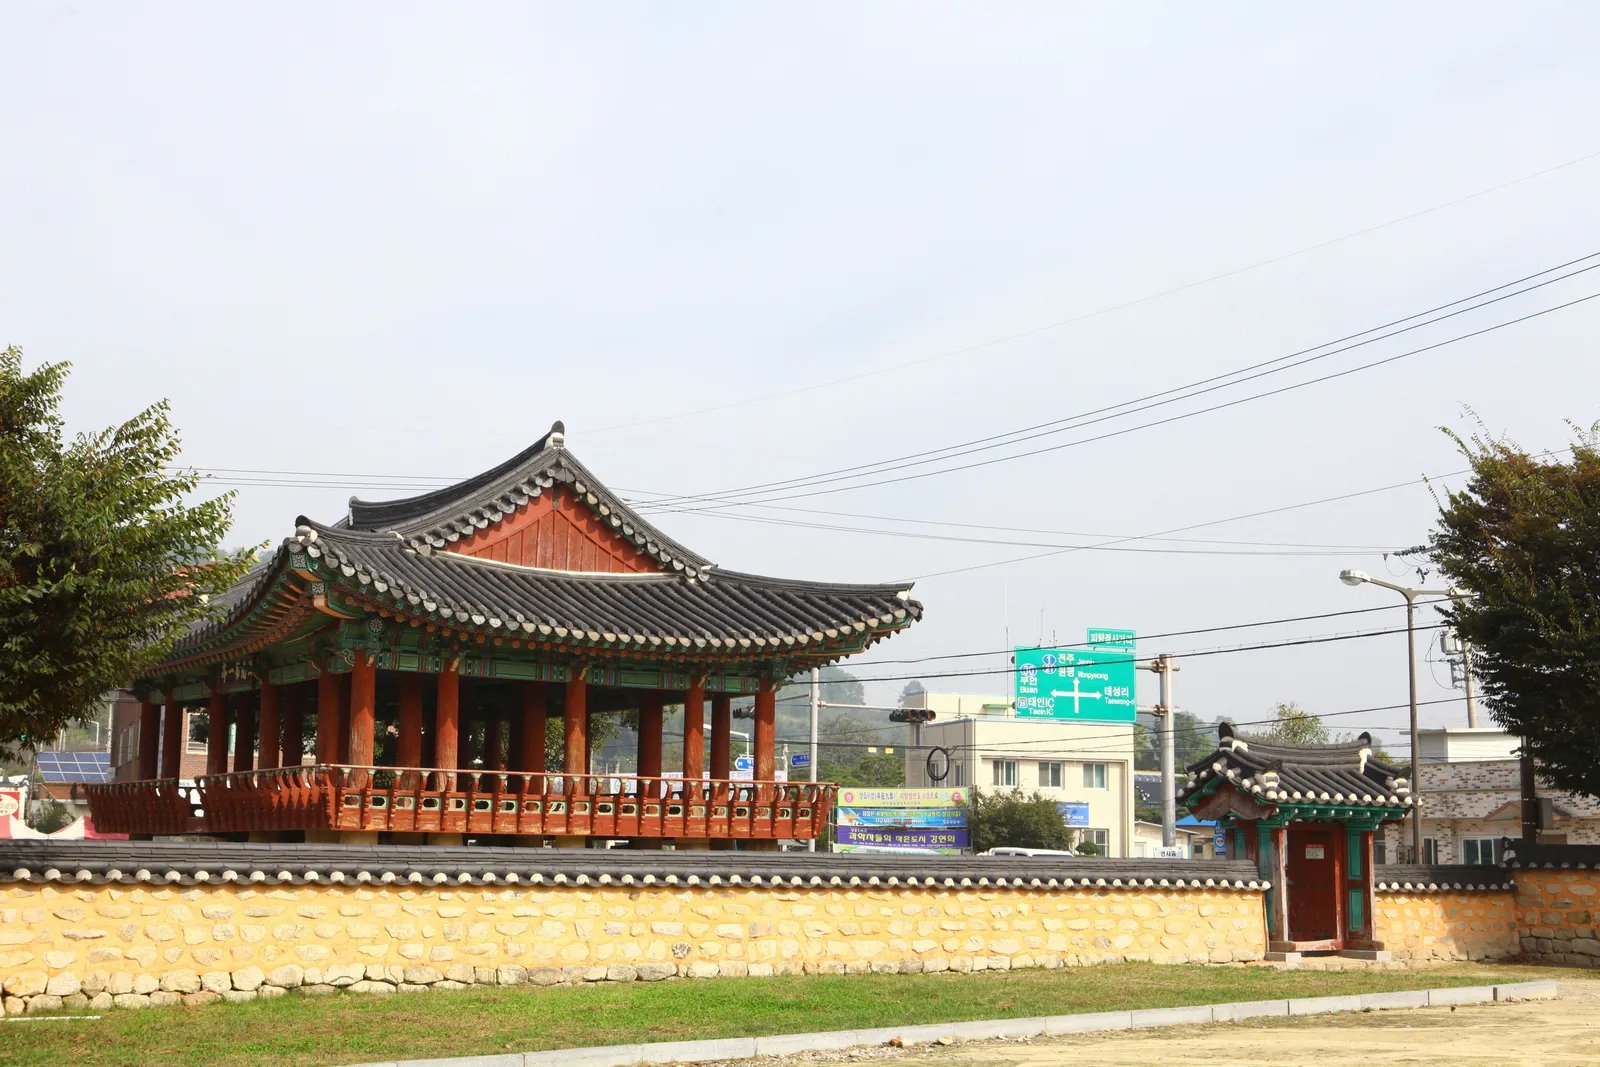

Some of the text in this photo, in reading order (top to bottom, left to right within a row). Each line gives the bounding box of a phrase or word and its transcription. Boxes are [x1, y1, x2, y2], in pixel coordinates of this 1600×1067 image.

[1058, 653, 1075, 664] 전주
[1058, 666, 1075, 677] 원평
[1077, 671, 1109, 680] Wonpyeong
[1020, 676, 1038, 686] 부안
[1020, 686, 1038, 694] Buan
[1104, 686, 1129, 697] 태성리
[849, 832, 892, 843] 과학자들의
